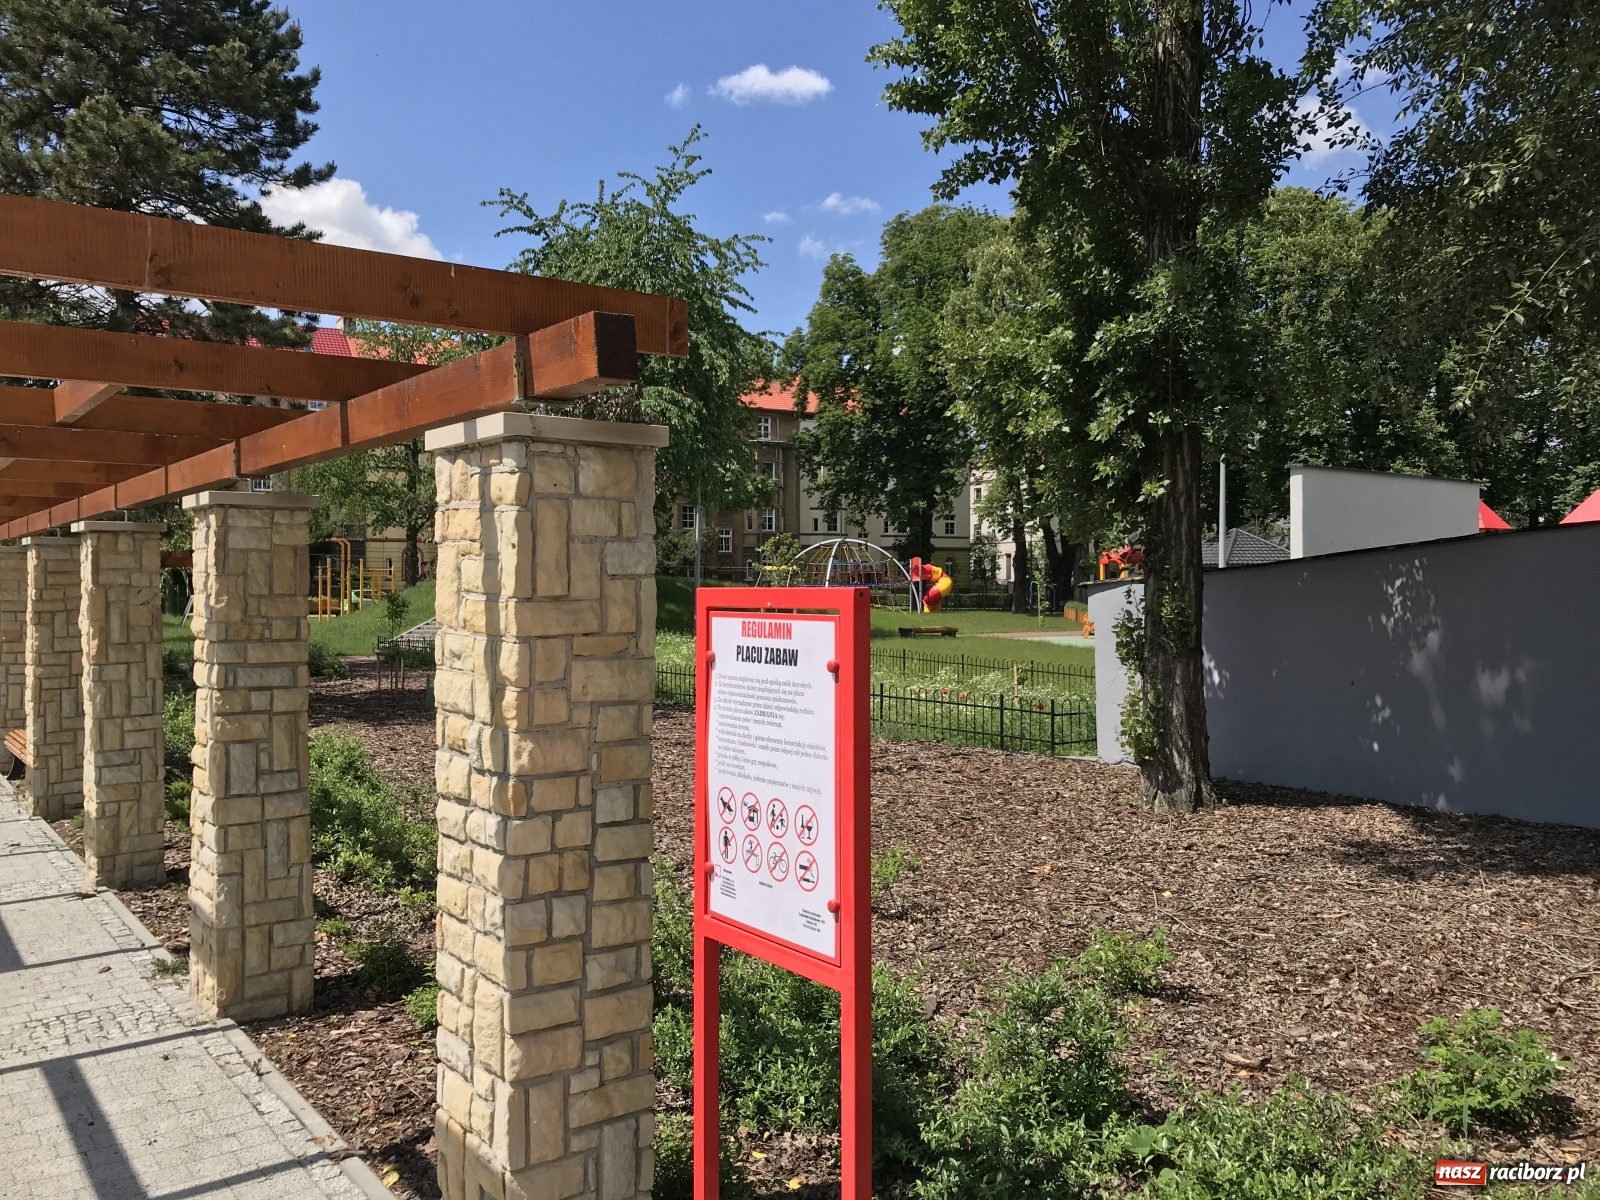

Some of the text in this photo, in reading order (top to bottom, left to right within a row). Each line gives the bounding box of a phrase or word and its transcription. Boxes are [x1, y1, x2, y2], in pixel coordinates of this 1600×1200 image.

[741, 620, 792, 640] REGULAMIN
[736, 645, 798, 666] PLACU ZABAW
[753, 709, 777, 718] ZABRANIA
